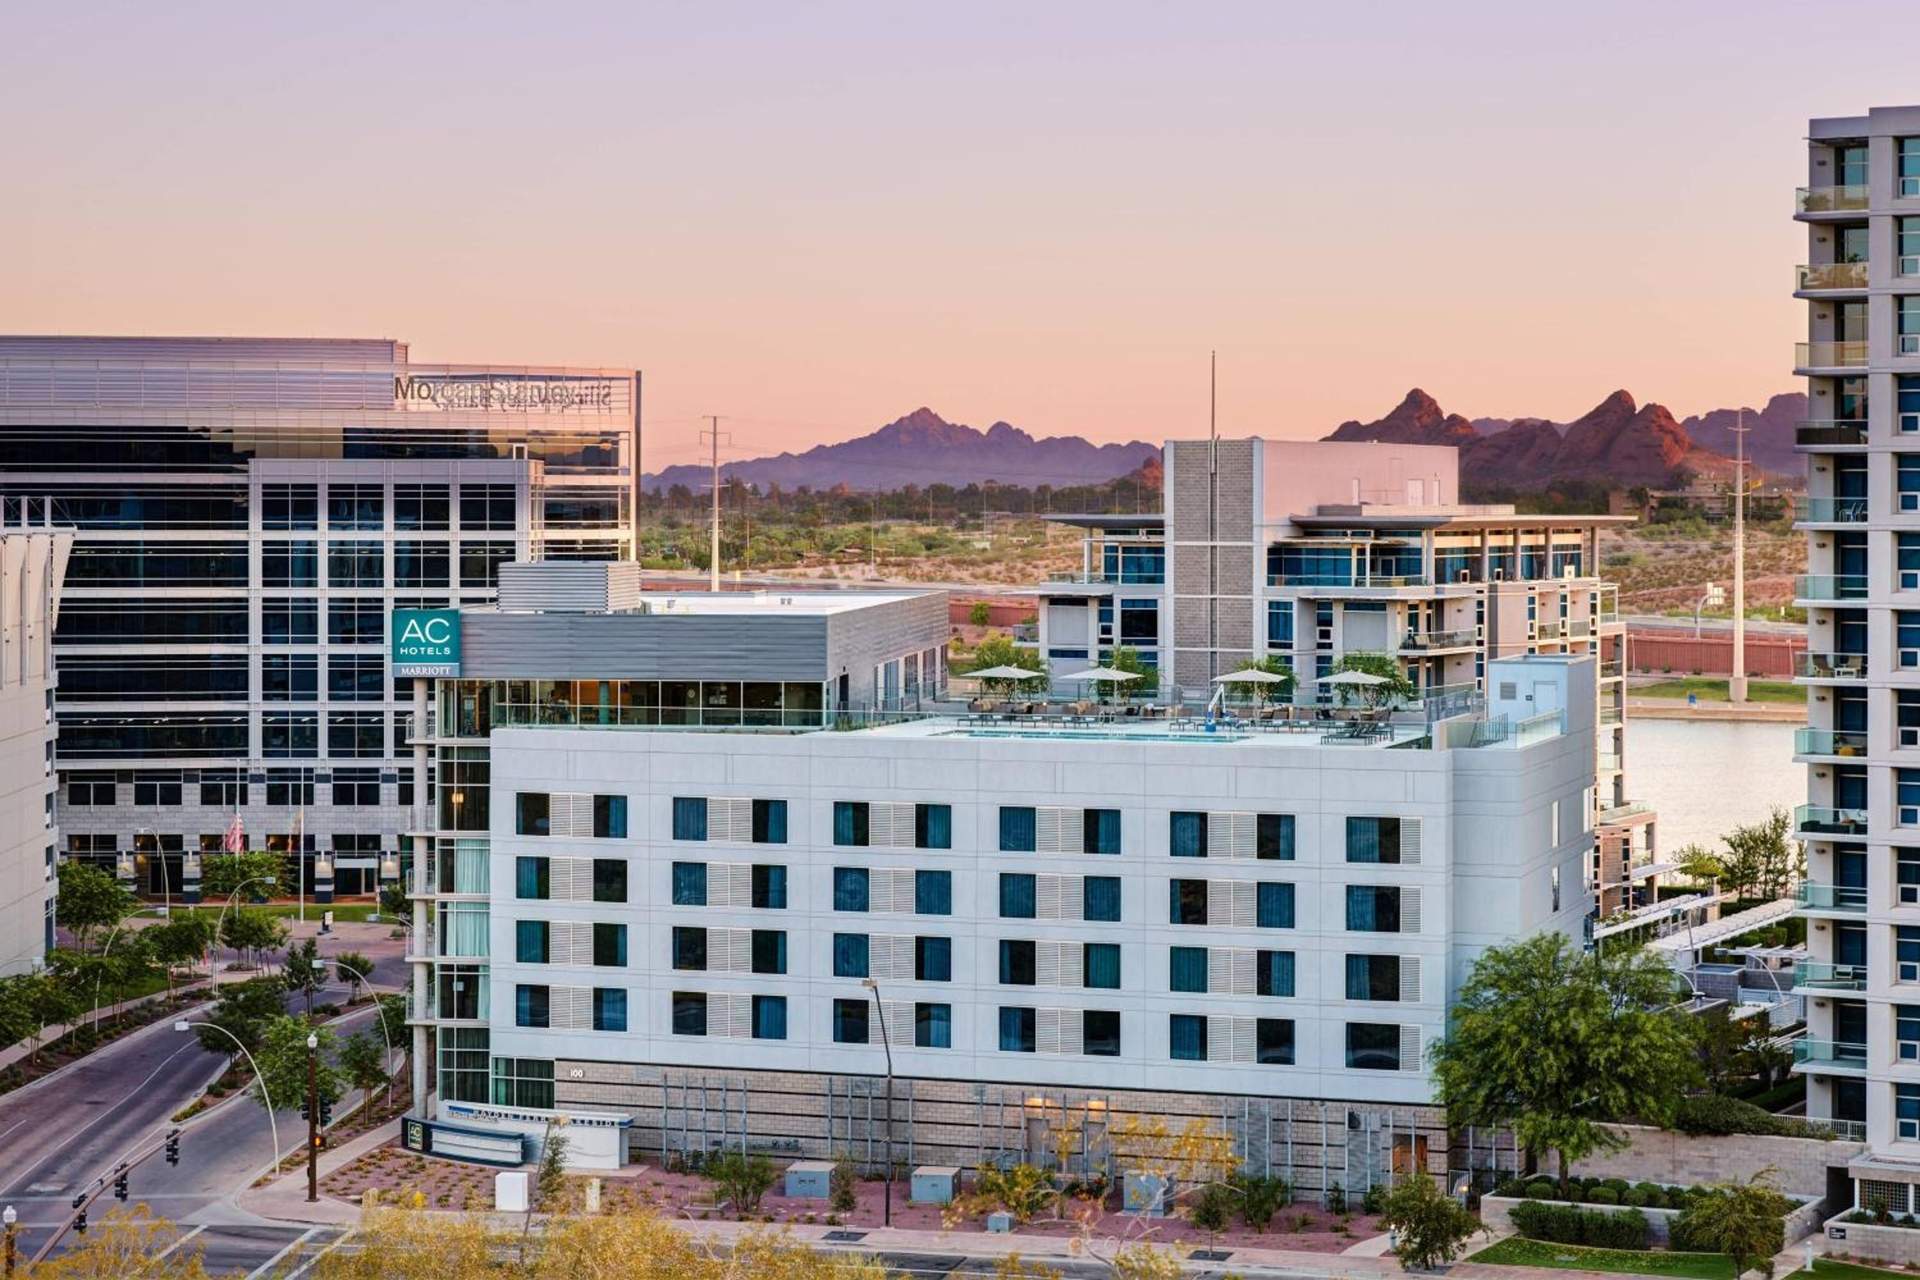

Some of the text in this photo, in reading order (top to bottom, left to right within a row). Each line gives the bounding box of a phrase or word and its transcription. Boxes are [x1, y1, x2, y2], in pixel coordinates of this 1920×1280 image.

[400, 618, 450, 643] AC
[400, 647, 450, 655] HOTELS
[401, 666, 450, 676] MARRIOTT
[570, 1069, 583, 1078] 100
